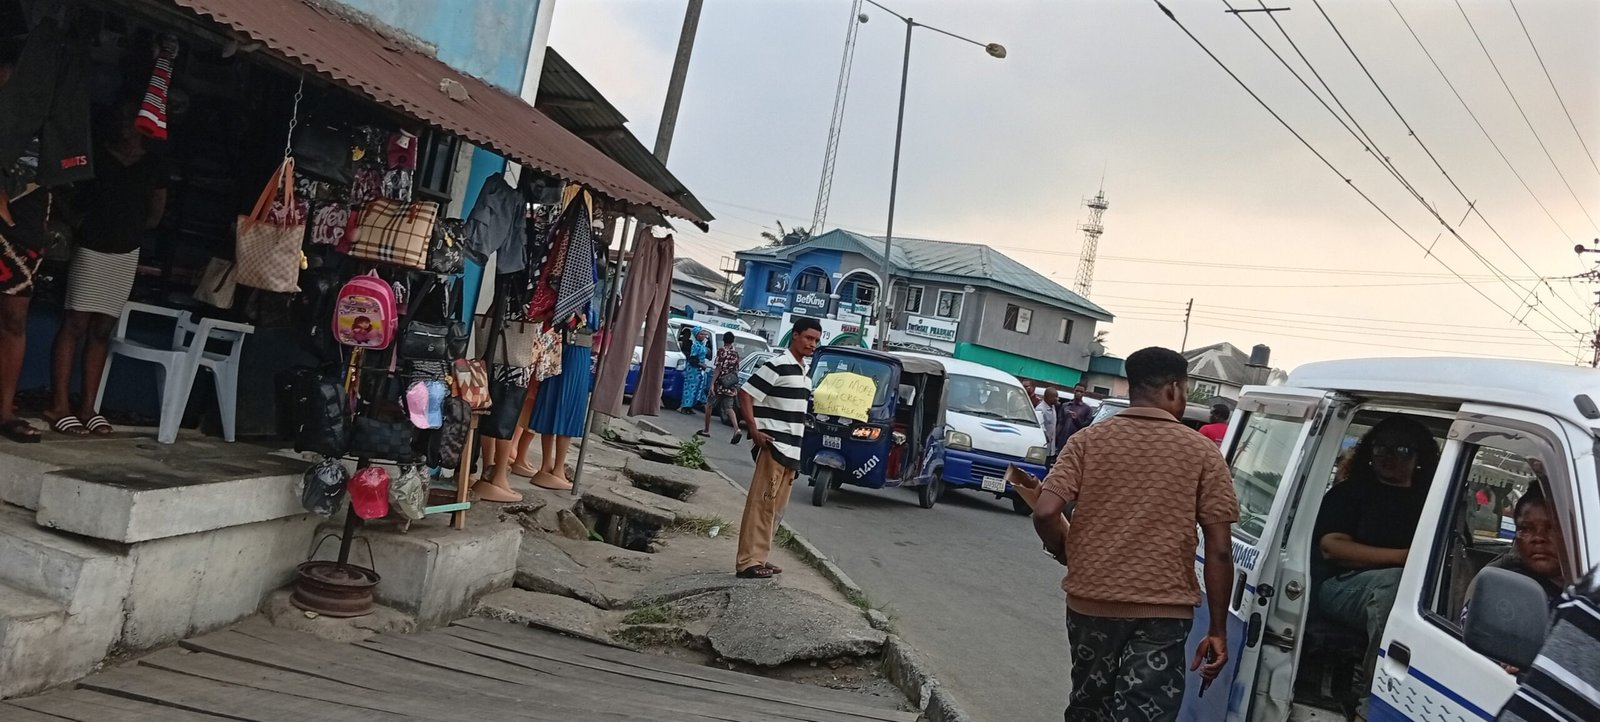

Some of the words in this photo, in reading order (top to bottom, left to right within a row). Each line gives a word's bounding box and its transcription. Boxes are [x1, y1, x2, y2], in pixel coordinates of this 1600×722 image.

[795, 293, 825, 308] BetKing
[930, 326, 955, 338] PHARMACY
[852, 455, 880, 479] 31401
